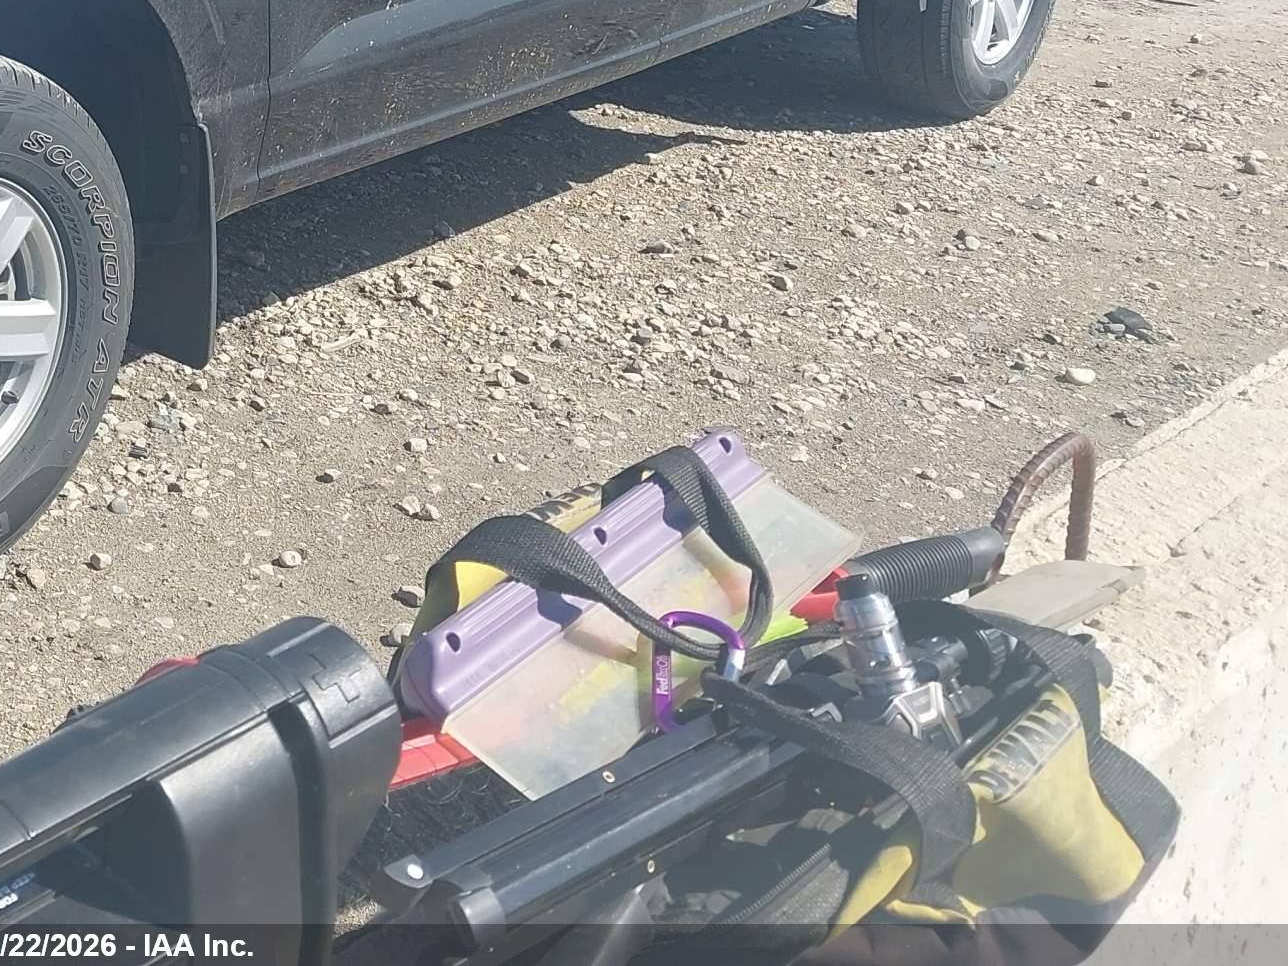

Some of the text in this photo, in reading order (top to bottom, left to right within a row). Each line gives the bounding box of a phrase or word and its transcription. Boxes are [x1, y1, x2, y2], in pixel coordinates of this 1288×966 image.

[21, 129, 121, 445] SCORPION ATR
[968, 699, 1070, 799] DEWALT
